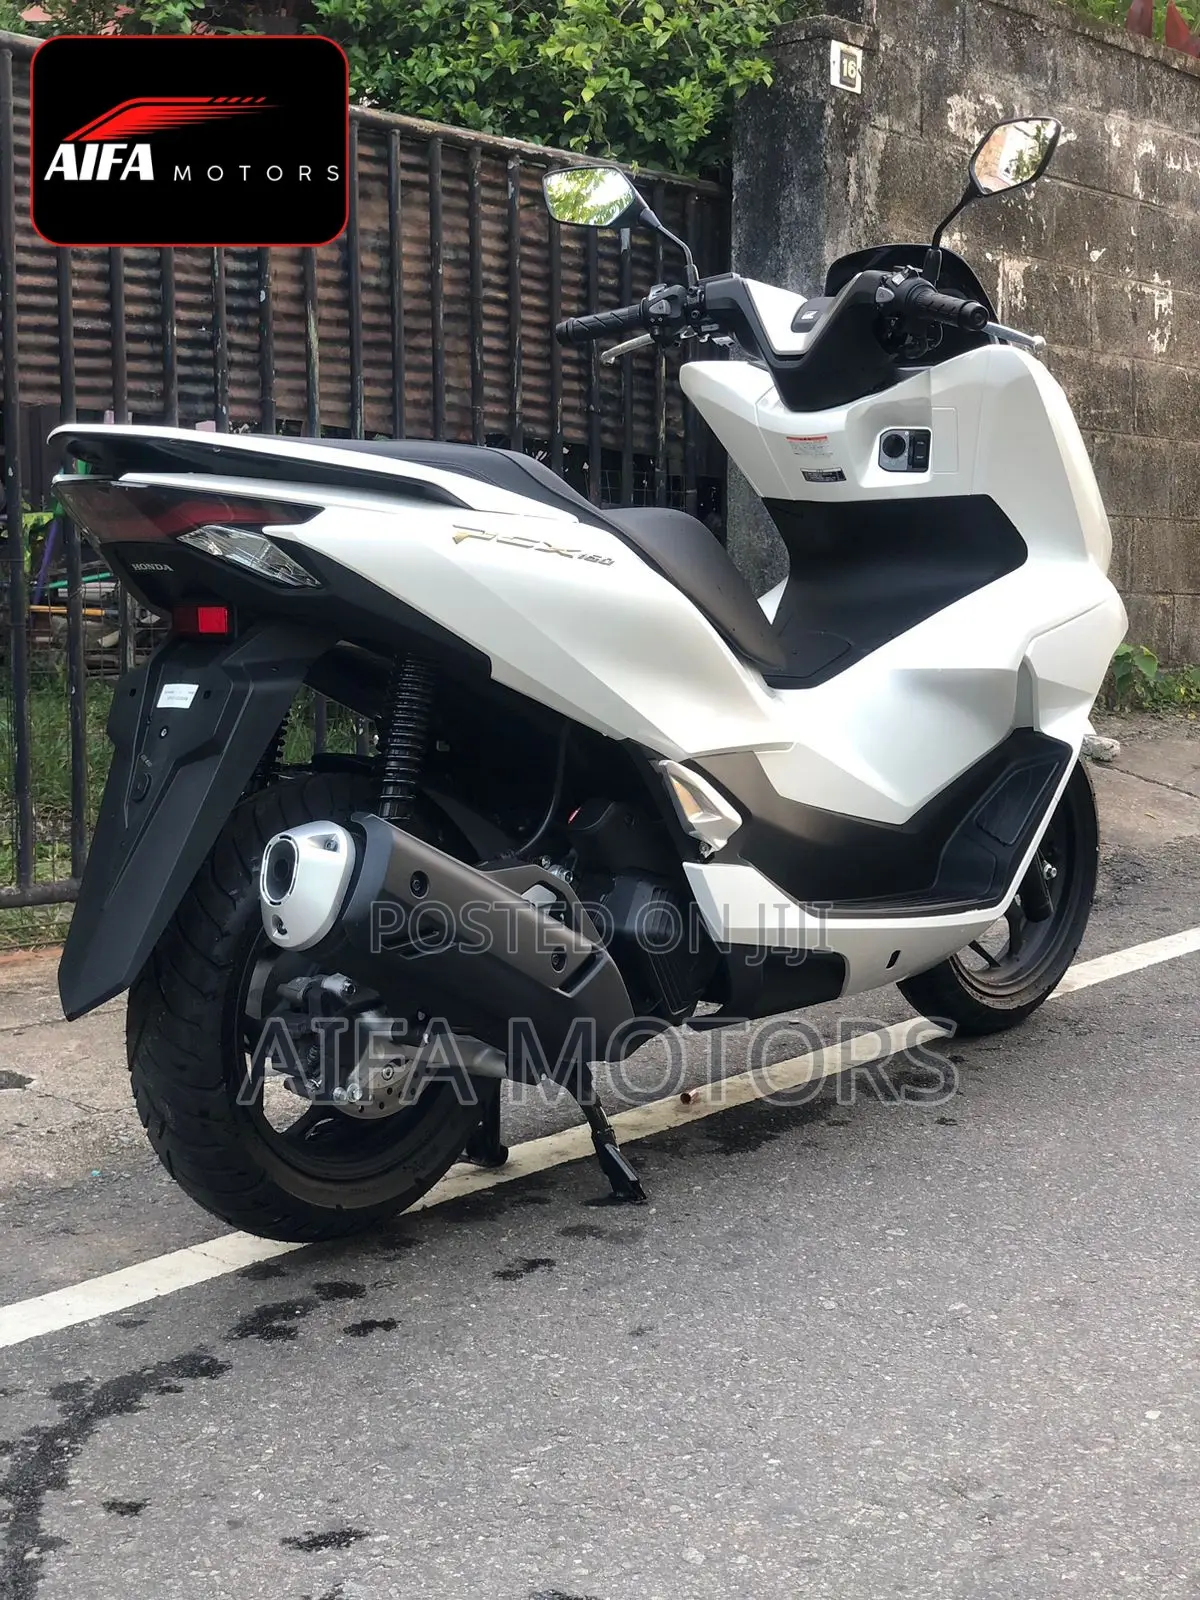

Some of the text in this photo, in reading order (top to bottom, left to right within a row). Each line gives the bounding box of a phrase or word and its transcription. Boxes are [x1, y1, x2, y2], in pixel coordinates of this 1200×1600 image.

[842, 58, 857, 79] 16
[452, 524, 615, 567] PCX 160
[131, 562, 175, 573] HONDA
